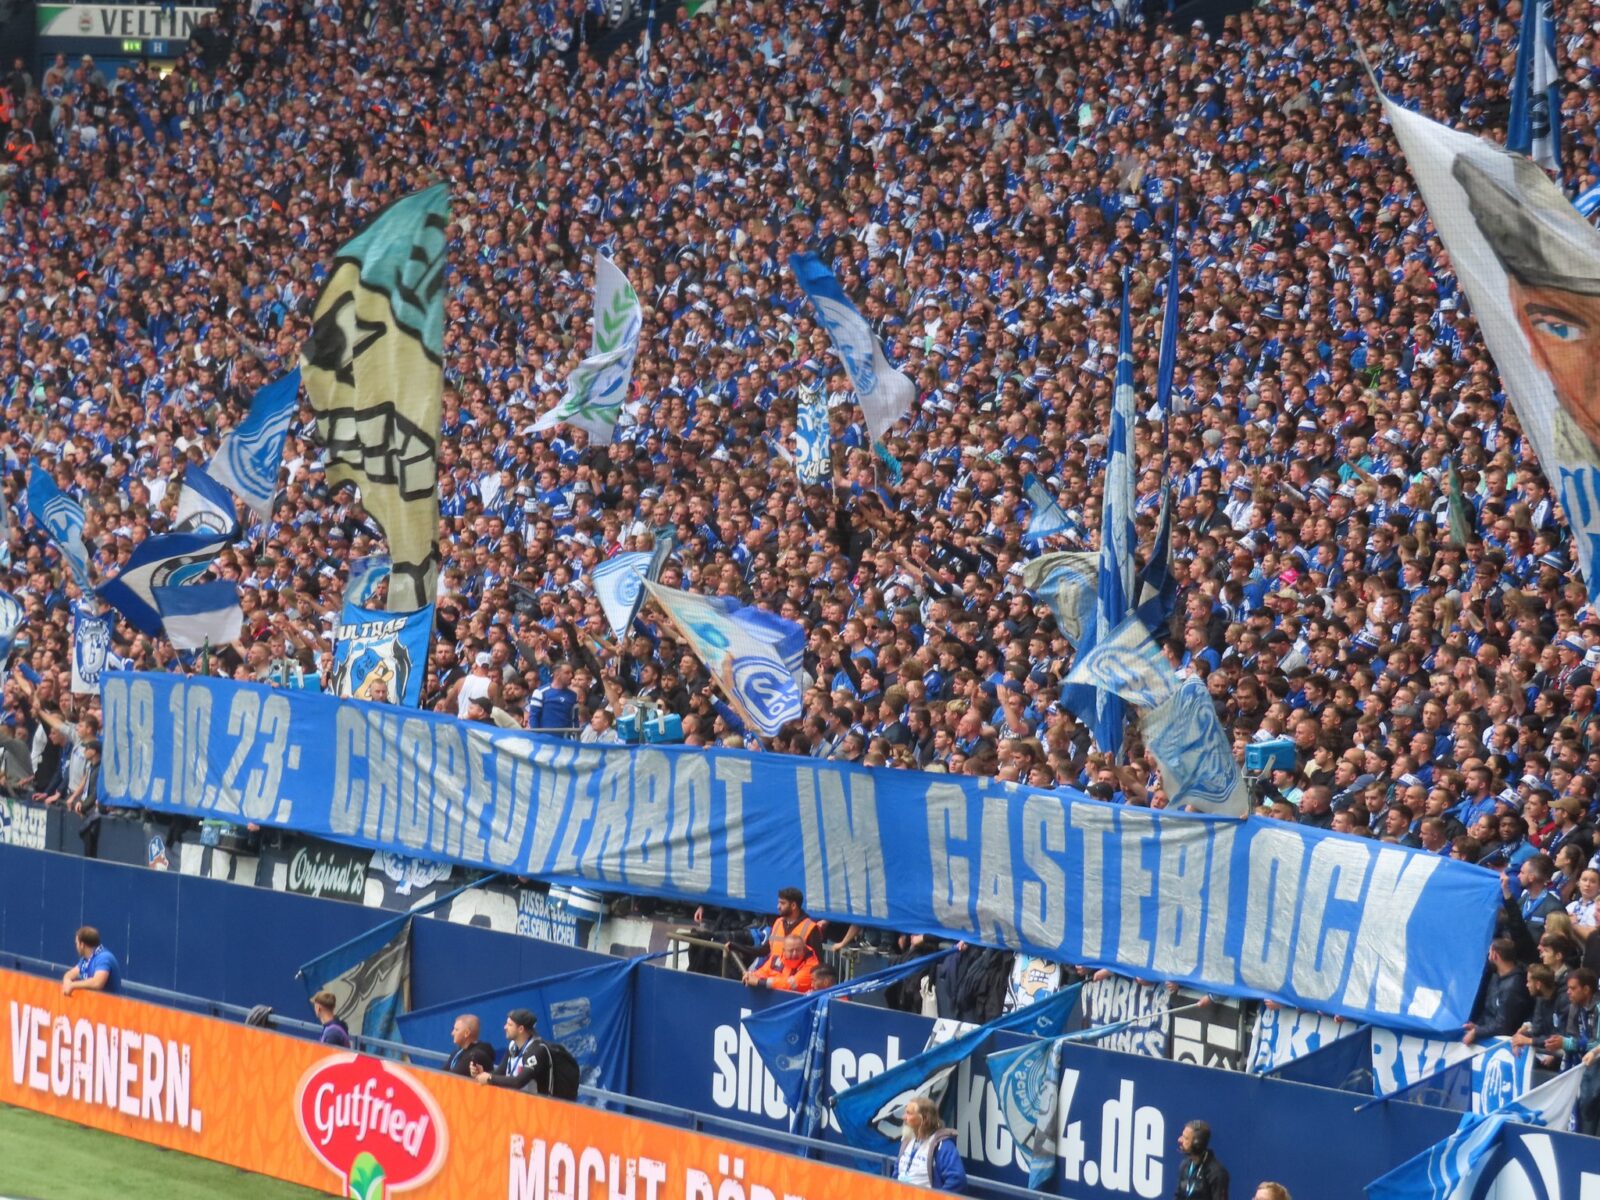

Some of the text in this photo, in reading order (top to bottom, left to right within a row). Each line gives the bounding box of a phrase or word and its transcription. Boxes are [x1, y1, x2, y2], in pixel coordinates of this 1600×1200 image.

[339, 616, 409, 640] ULTRAS
[13, 801, 47, 835] BLUE
[100, 677, 301, 823] 08.10.23:
[329, 705, 752, 898] CHOREOVERBOT
[796, 766, 888, 919] IM
[518, 913, 576, 947] GELSENKIRCHEN
[10, 1001, 203, 1133] VEGANERN.
[312, 1078, 430, 1157] Gutfried
